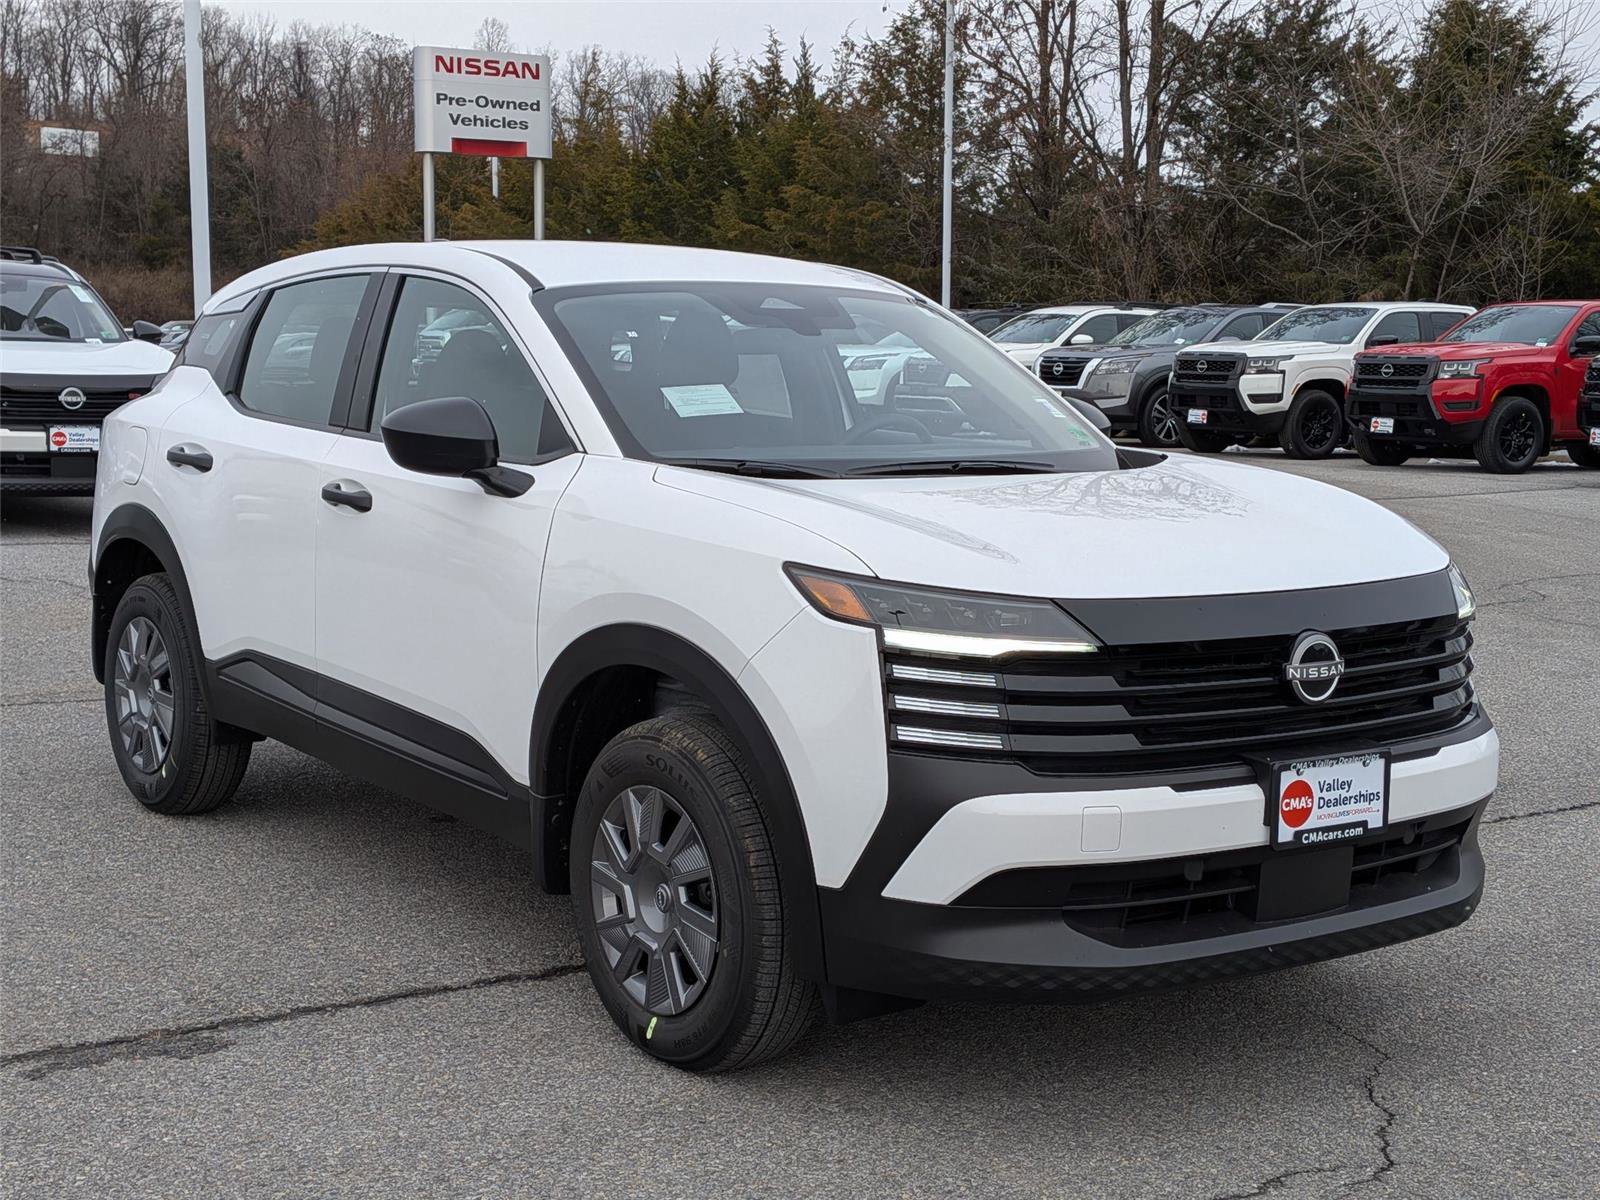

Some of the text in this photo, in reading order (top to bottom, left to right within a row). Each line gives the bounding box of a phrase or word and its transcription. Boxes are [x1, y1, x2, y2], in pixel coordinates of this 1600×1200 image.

[435, 55, 540, 80] NISSAN
[436, 92, 541, 112] Pre-Owned
[449, 113, 529, 130] Vehicles
[1289, 663, 1344, 678] NISSAN
[1339, 753, 1380, 765] Dealerships
[1318, 779, 1353, 793] Valley
[1282, 796, 1312, 811] CMA's
[1317, 789, 1381, 809] Dealerships
[1302, 827, 1363, 844] CMAcars.com
